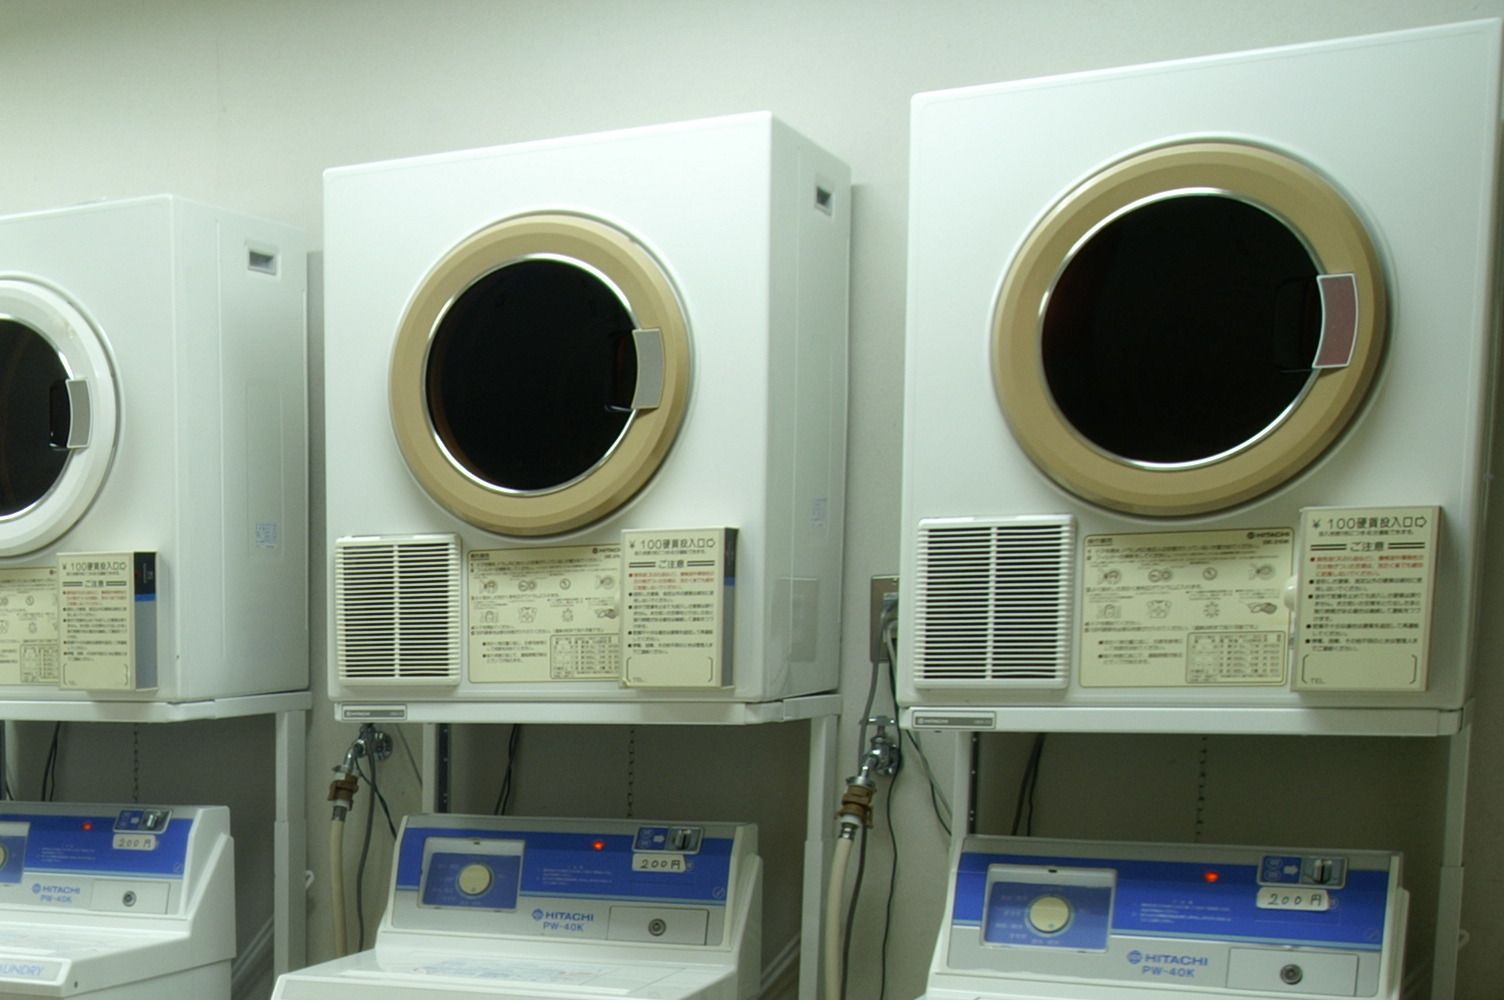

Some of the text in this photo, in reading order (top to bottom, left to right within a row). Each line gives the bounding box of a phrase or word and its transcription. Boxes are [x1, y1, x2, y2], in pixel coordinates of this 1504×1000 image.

[640, 859, 681, 870] 200円
[43, 885, 81, 895] HITACHI
[1267, 893, 1322, 906] 200円
[545, 911, 594, 922] HITACHI
[543, 921, 585, 932] PW-40K
[1145, 954, 1208, 966] HITACHI
[1142, 966, 1195, 977] PW-40K
